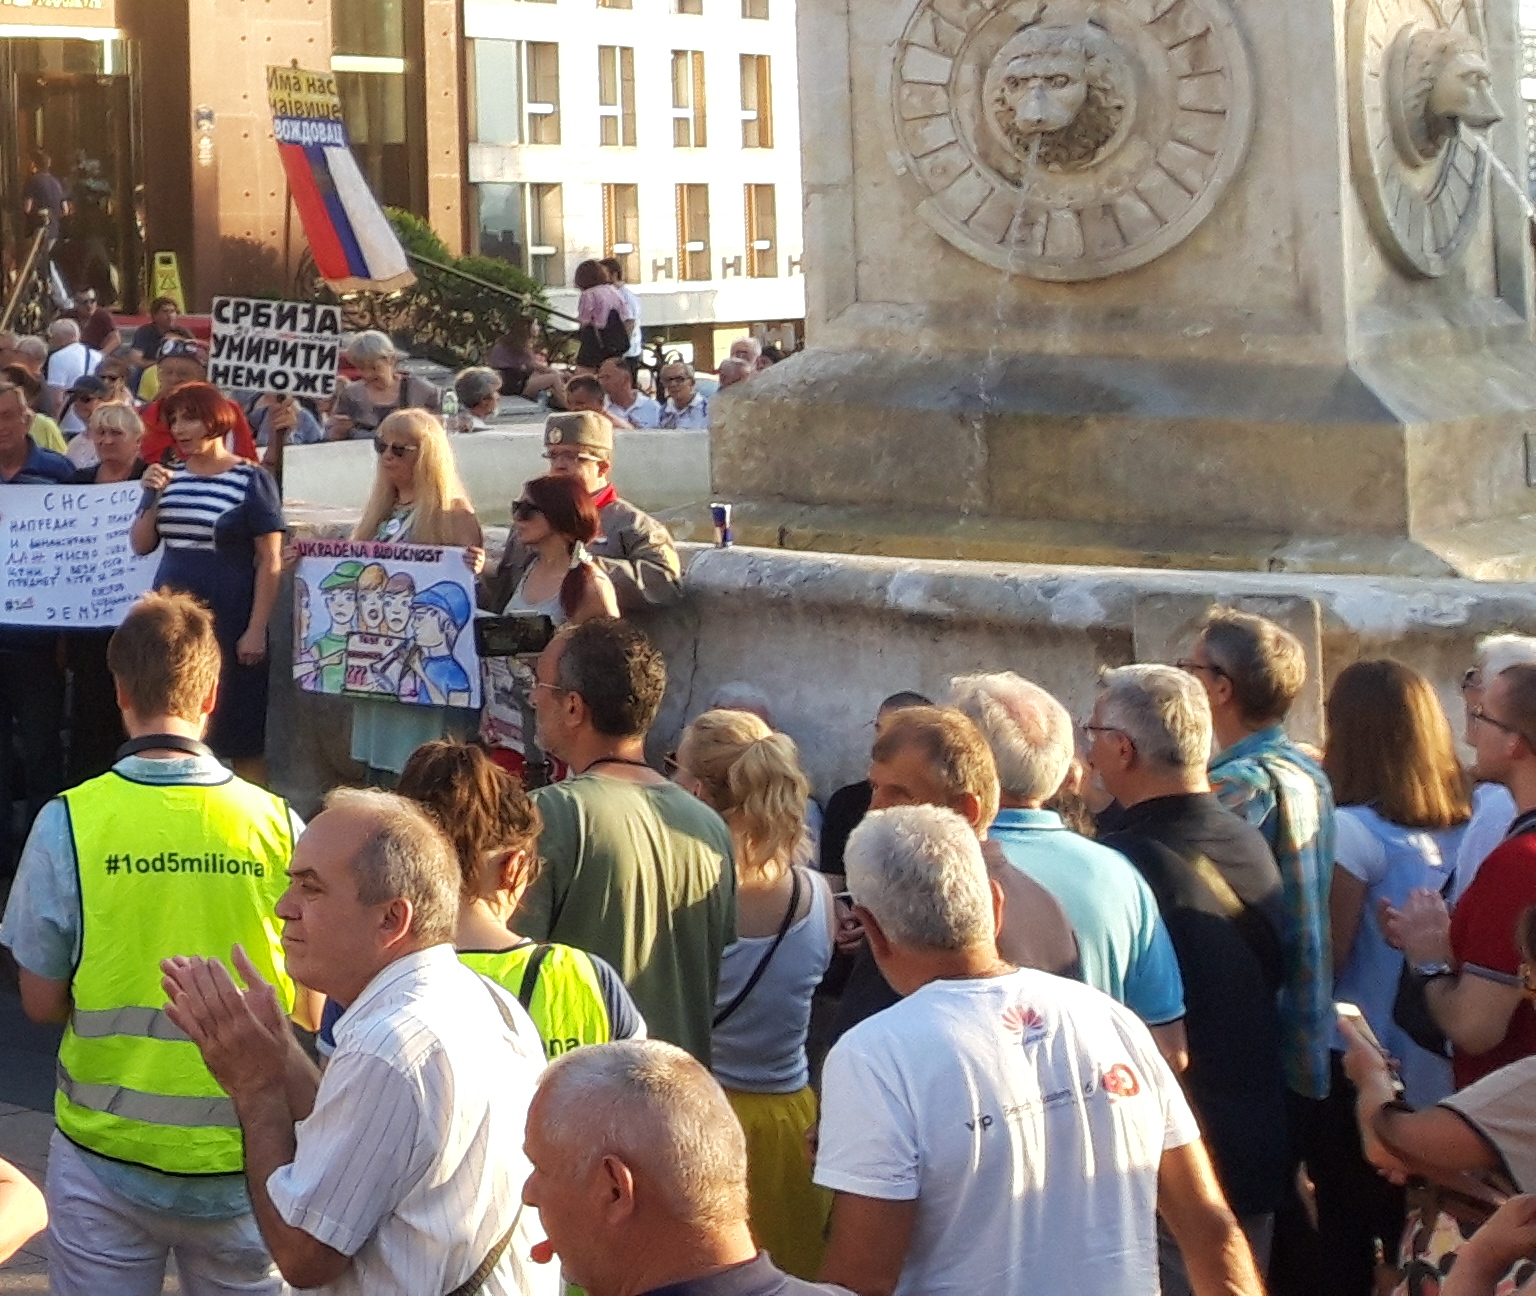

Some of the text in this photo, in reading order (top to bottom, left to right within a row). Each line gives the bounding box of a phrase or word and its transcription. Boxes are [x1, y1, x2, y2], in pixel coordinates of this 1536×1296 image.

[306, 76, 336, 95] нас
[214, 299, 340, 335] СРБИЈА
[211, 334, 337, 371] УМИРИТИ
[211, 364, 335, 394] НЕМОЖЕ
[44, 492, 88, 511] СНС
[298, 542, 368, 558] UKRADENA
[105, 851, 265, 878] #1od5miliona
[964, 1114, 993, 1132] vp
